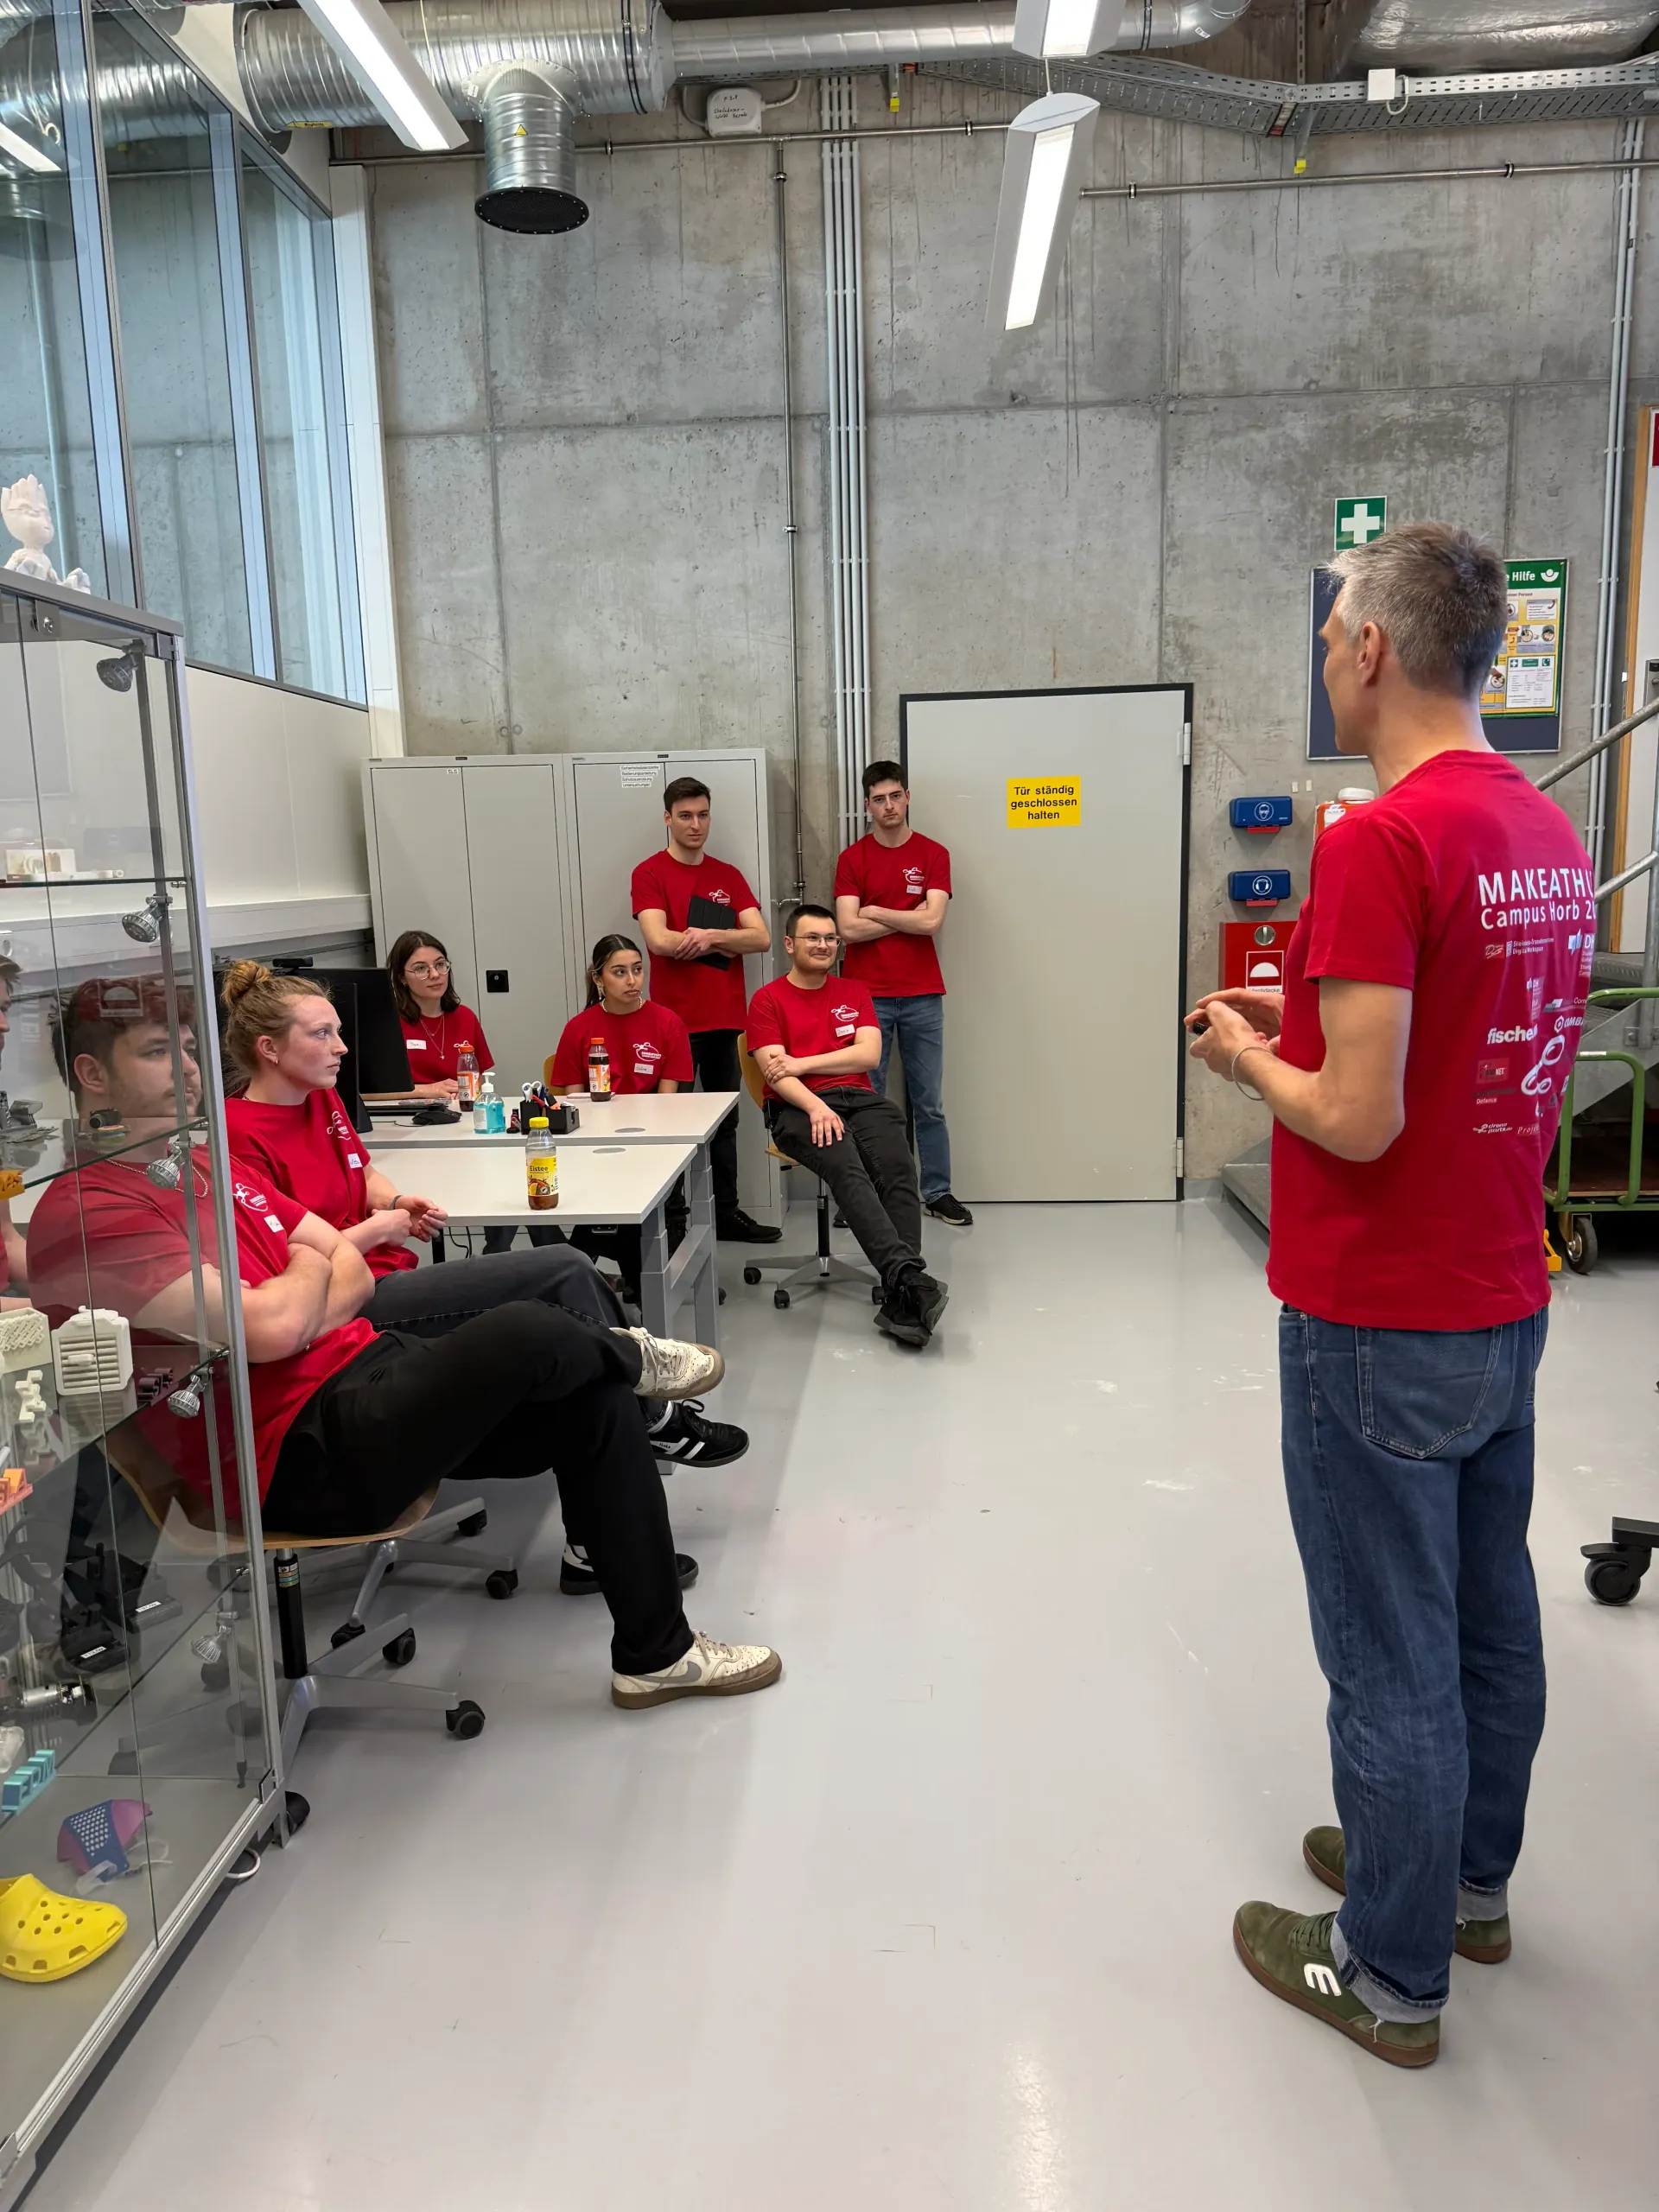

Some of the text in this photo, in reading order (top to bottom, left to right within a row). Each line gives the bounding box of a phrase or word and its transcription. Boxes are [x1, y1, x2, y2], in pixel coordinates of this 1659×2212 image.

[1511, 571, 1535, 582] Hilfe
[1014, 785, 1074, 796] Tür ständig
[1010, 798, 1077, 810] geschlossen
[1027, 810, 1060, 820] halten
[1480, 905, 1547, 931] Campus
[1548, 899, 1580, 922] Horb
